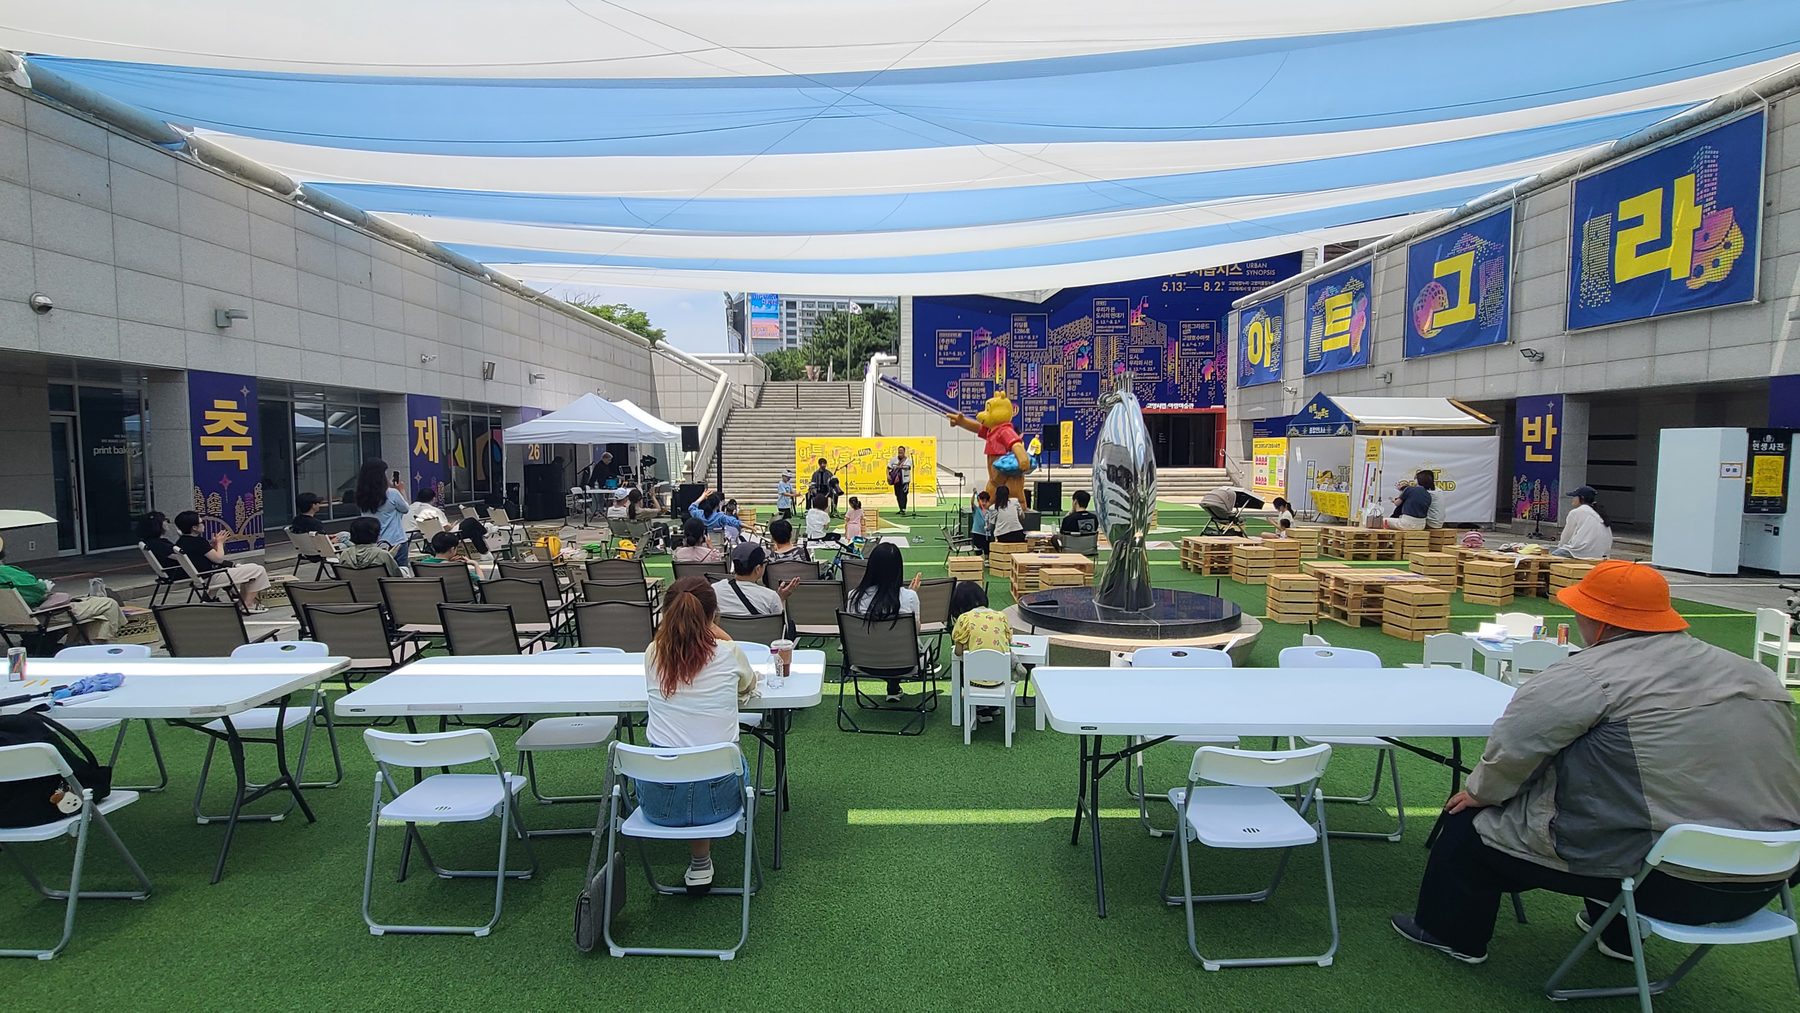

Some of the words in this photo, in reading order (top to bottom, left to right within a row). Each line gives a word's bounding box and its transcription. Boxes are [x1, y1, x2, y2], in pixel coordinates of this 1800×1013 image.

[1615, 174, 1703, 284] 라
[1432, 250, 1477, 328] 그
[1247, 317, 1275, 368] 아
[1322, 292, 1354, 353] 트
[93, 446, 112, 456] print
[200, 399, 253, 470] 축
[413, 416, 439, 463] 제
[1522, 413, 1558, 462] 반
